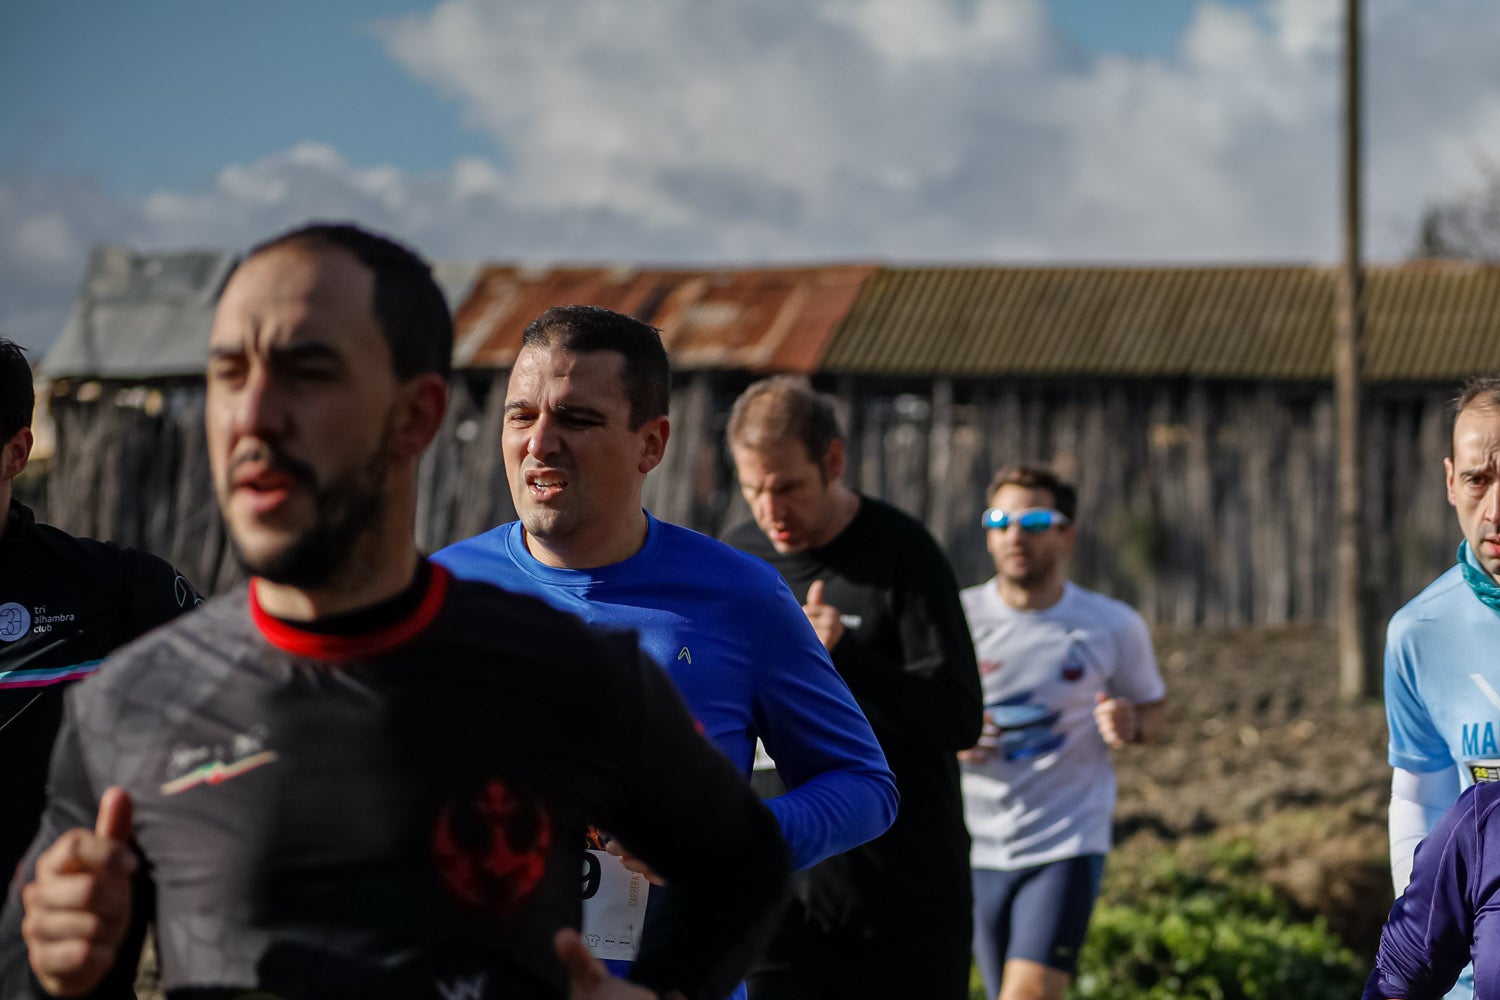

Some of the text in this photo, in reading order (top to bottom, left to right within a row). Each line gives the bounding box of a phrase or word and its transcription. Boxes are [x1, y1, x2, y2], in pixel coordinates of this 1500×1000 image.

[34, 605, 46, 614] tri
[34, 614, 75, 624] alhambra
[33, 624, 53, 633] club
